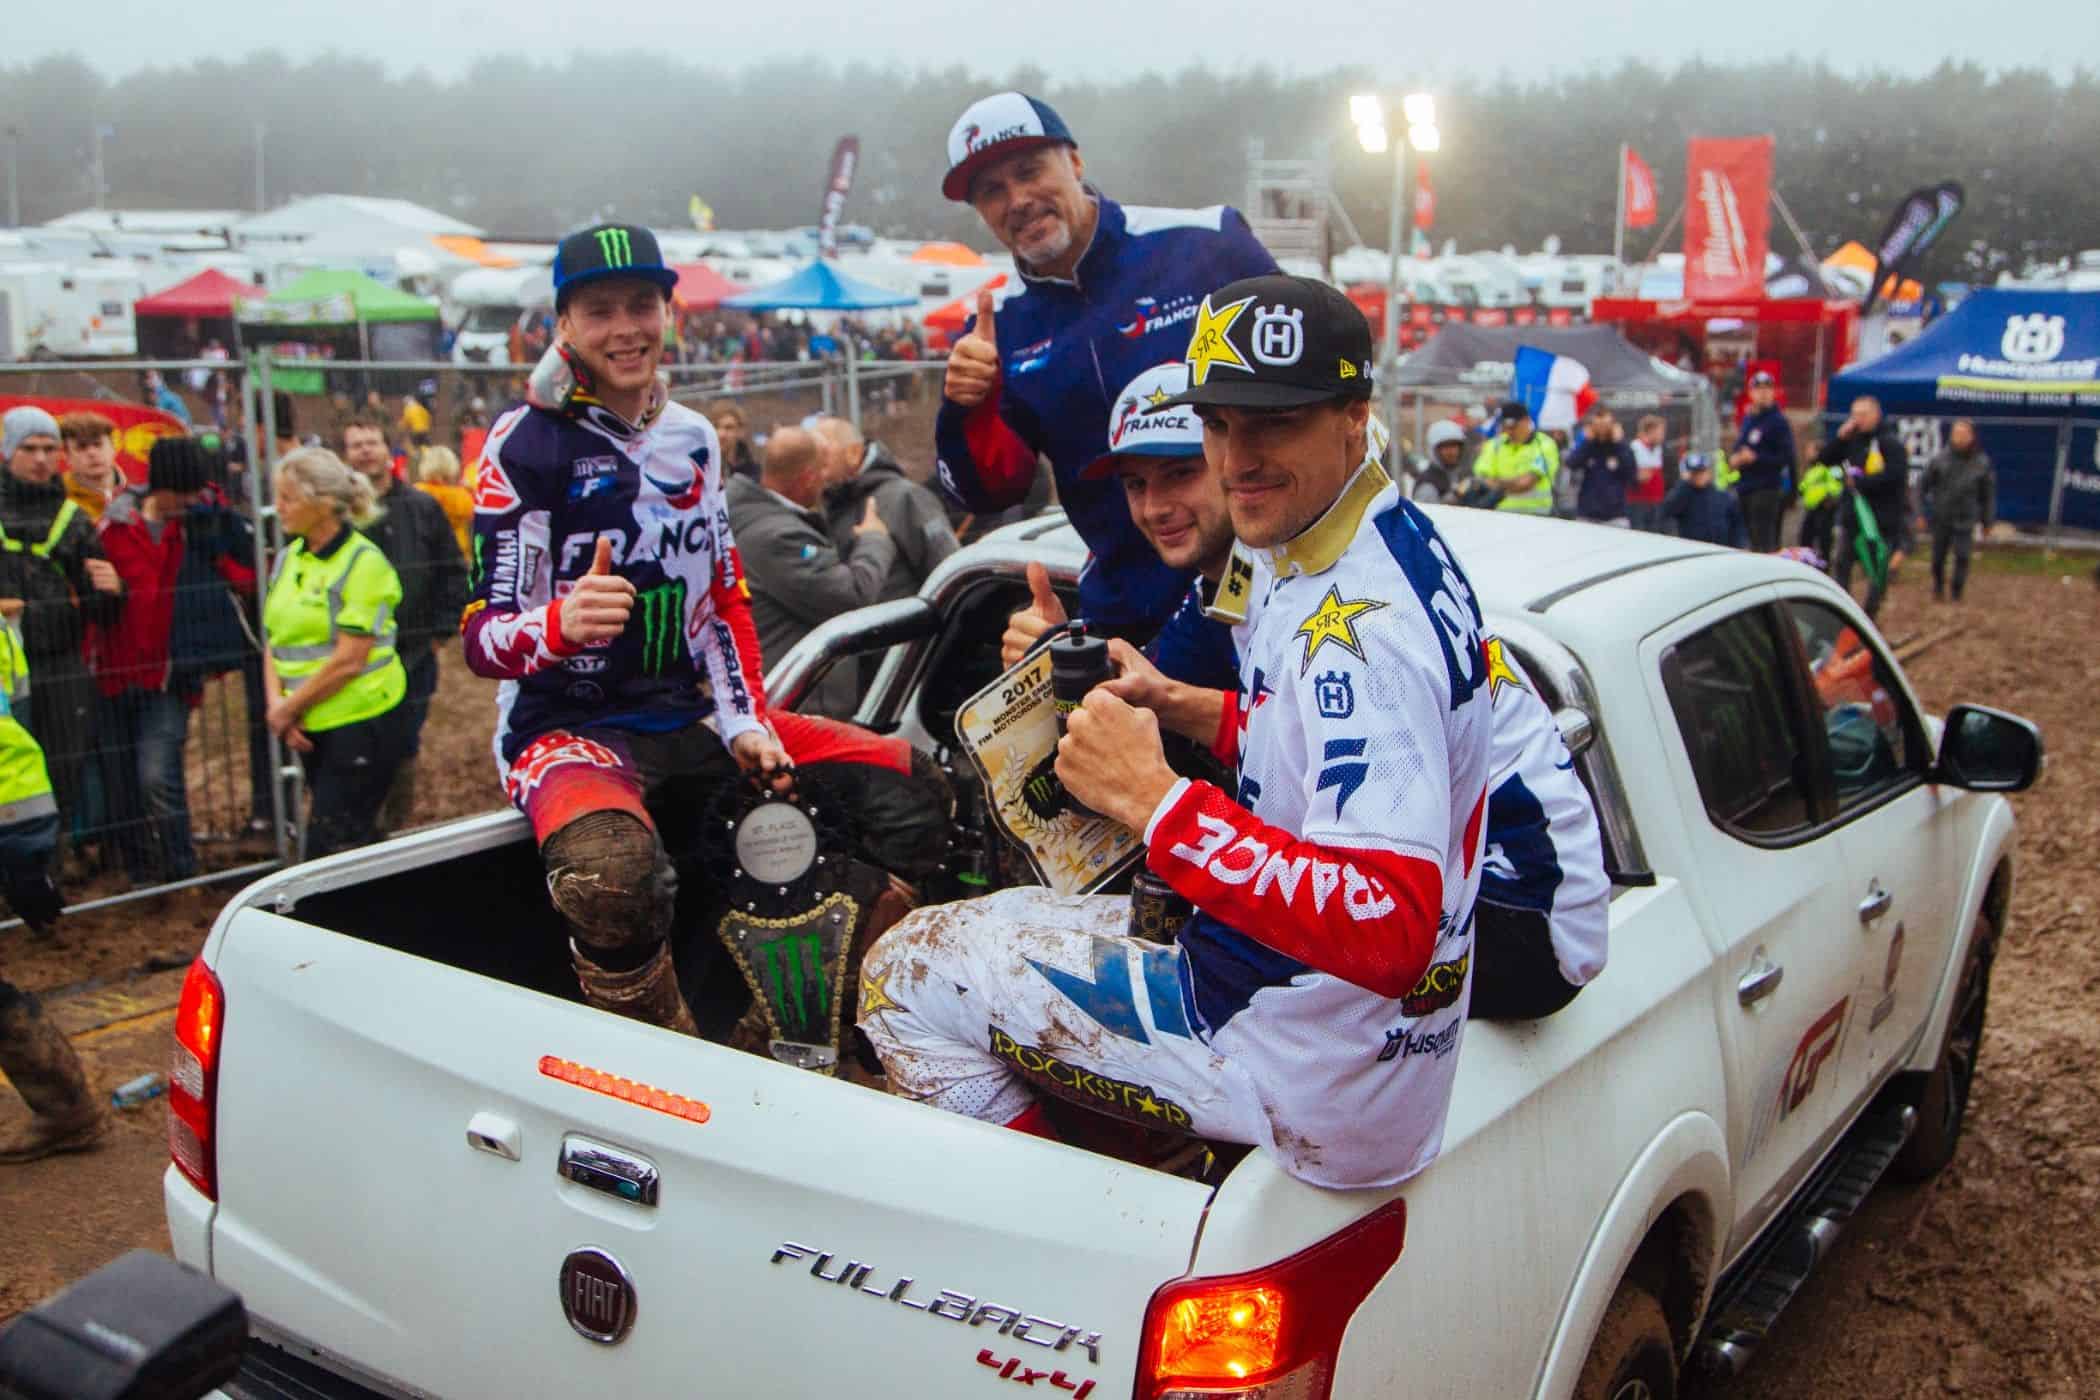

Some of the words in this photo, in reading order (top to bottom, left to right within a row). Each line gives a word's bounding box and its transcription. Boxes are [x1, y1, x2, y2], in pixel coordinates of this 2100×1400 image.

[1122, 416, 1190, 436] FRANCE
[490, 530, 518, 603] YAMAHA
[992, 691, 1034, 725] MONSTER
[1001, 666, 1044, 705] 2017
[976, 729, 994, 748] FIM
[992, 696, 1044, 736] MOTOCROSS
[575, 1270, 619, 1323] FIAT
[769, 1240, 1102, 1365] FULLBACK
[975, 1348, 1097, 1400] 4x4
